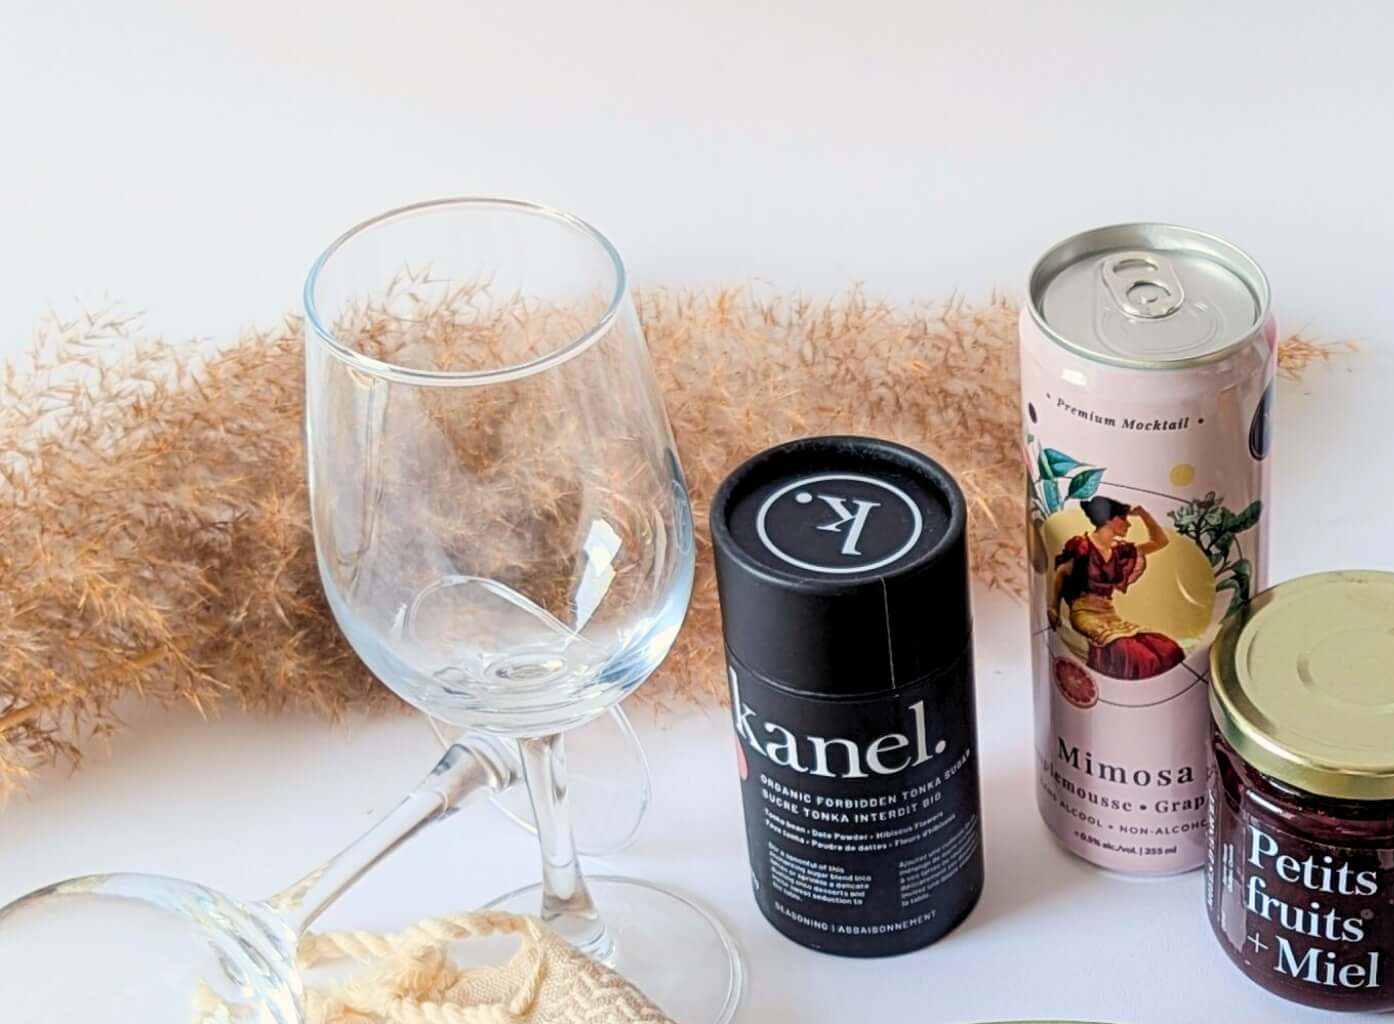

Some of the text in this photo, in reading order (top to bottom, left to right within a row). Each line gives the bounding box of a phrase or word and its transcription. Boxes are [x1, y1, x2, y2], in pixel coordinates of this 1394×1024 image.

[1057, 397, 1190, 431] Premium Mocktail
[1057, 736, 1195, 786] Mimosa
[760, 773, 812, 804] ORGANIC
[816, 795, 897, 809] FORBIDDEN
[902, 777, 942, 800] TONKA
[762, 788, 799, 815] SUCRE
[803, 807, 850, 823] TONKA
[854, 804, 918, 823] INTERDIT
[1059, 801, 1103, 829] ALCOOL
[1249, 825, 1378, 896] Petits
[774, 902, 828, 931] SEASONING
[1247, 876, 1365, 943] fruits
[1247, 933, 1380, 988] + Miel
